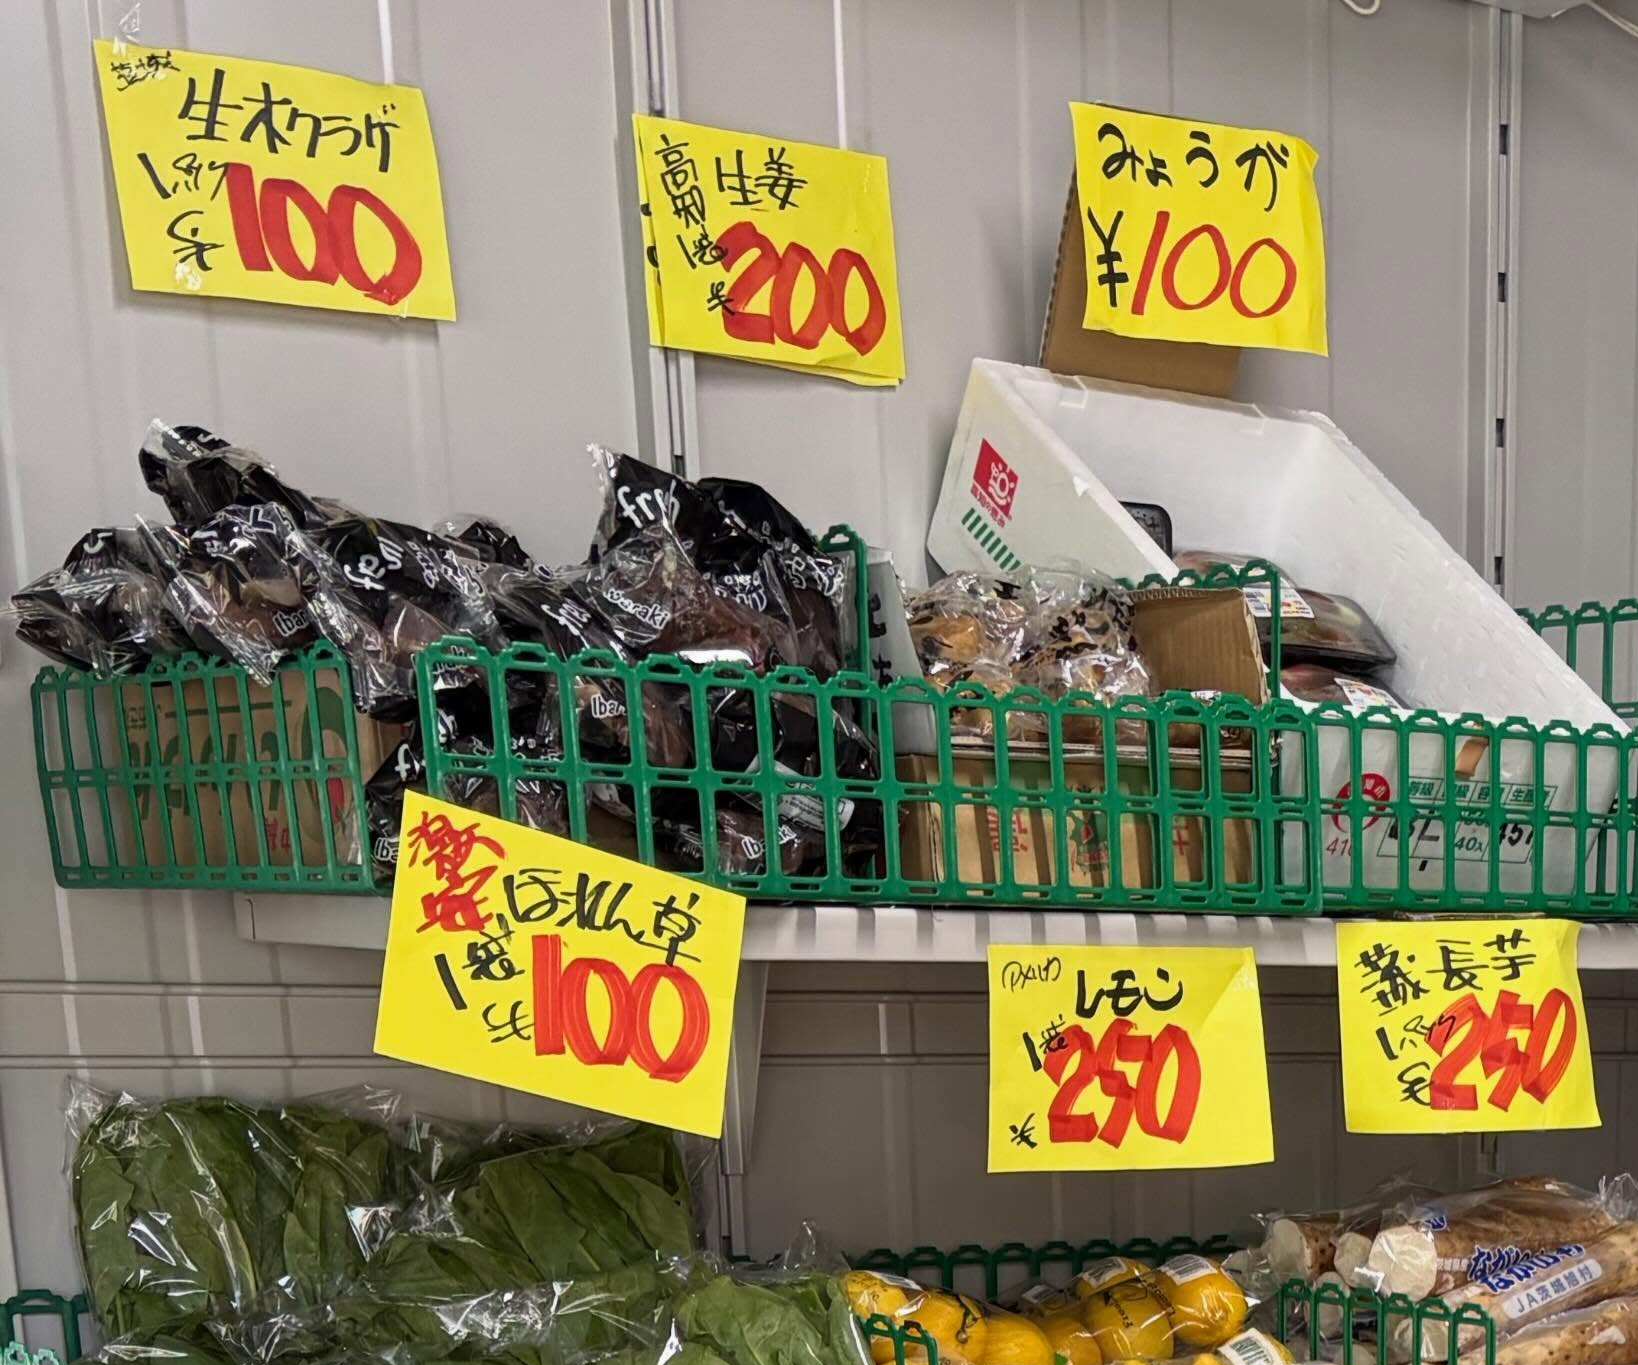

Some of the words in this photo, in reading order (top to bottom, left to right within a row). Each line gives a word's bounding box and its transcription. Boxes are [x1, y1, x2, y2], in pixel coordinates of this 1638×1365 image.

[714, 147, 808, 211] 生姜
[1097, 122, 1290, 212] みょうが
[1426, 928, 1537, 992] 長芋
[1075, 967, 1184, 1019] レモン
